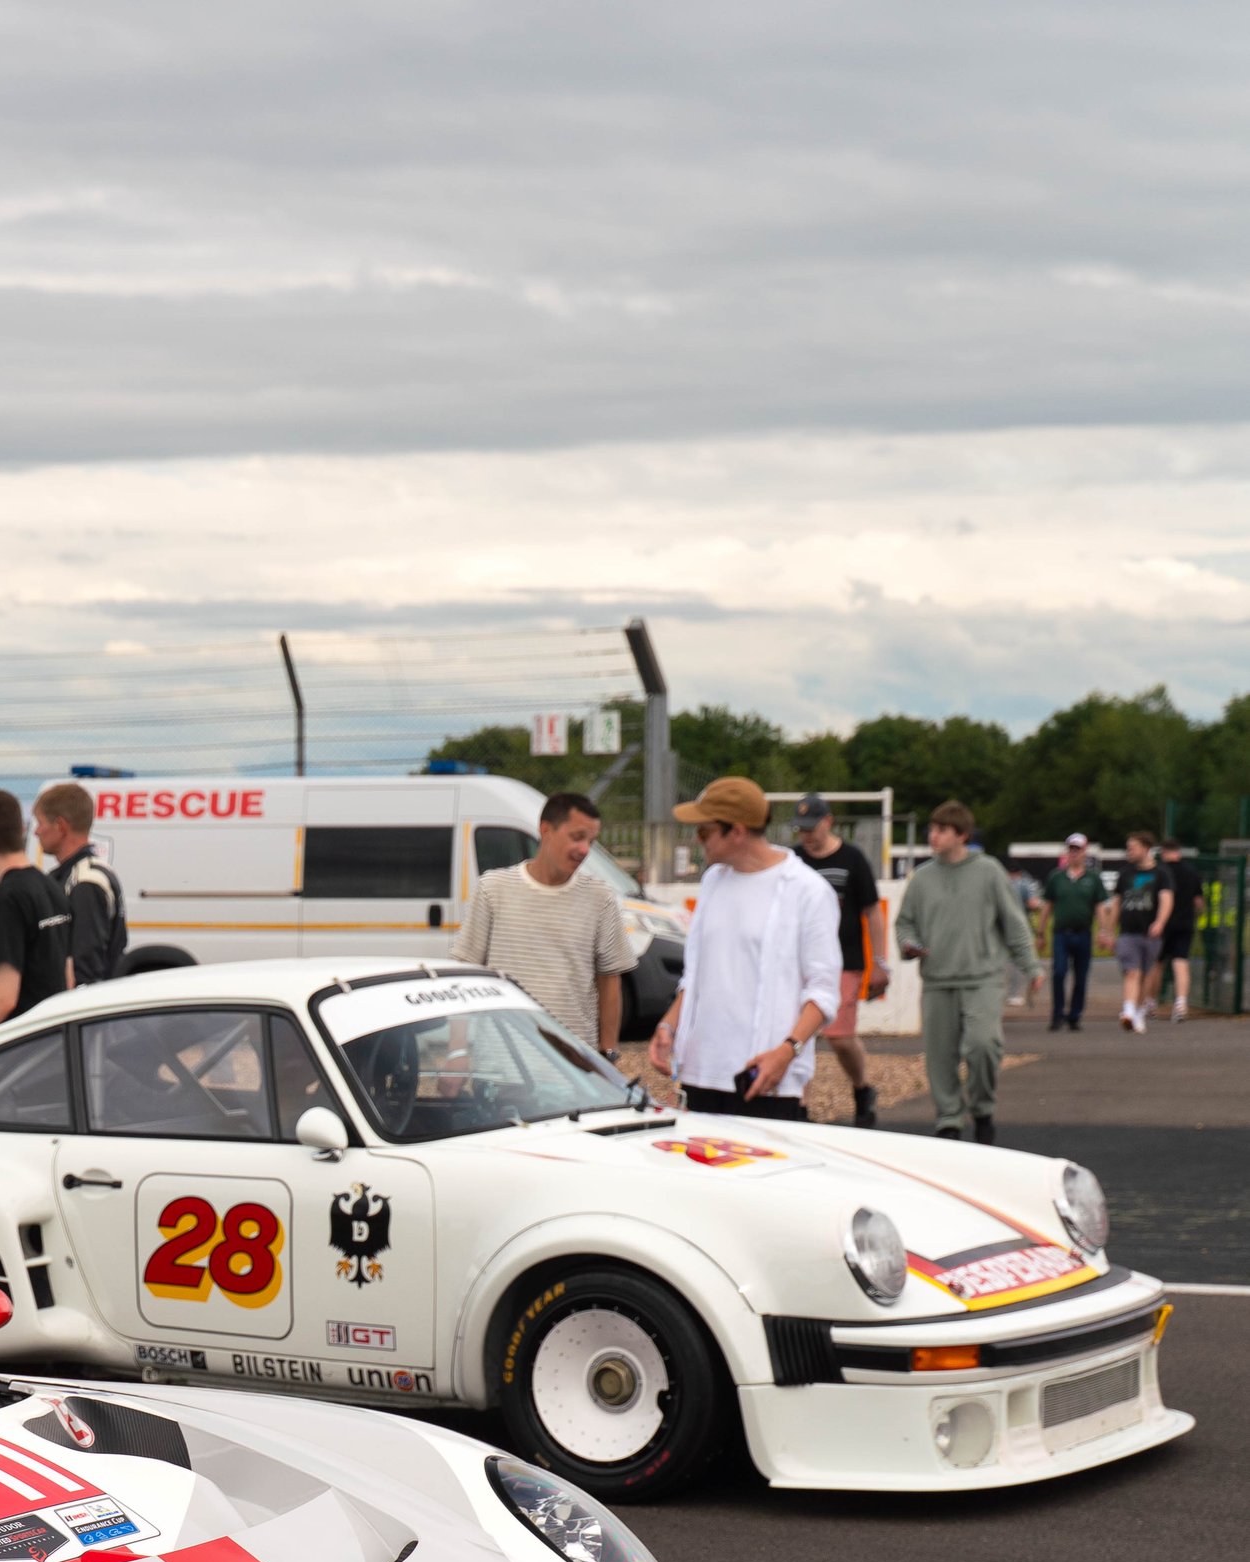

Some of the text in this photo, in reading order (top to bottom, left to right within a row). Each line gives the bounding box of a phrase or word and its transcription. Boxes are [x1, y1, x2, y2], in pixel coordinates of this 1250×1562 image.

[96, 790, 264, 819] RESCUE
[144, 1196, 283, 1307] 28
[352, 1327, 392, 1345] GT
[139, 1345, 189, 1363] BOSCH
[232, 1354, 323, 1383] BILSTEIN
[75, 1515, 125, 1534] ENDURANCE CUP
